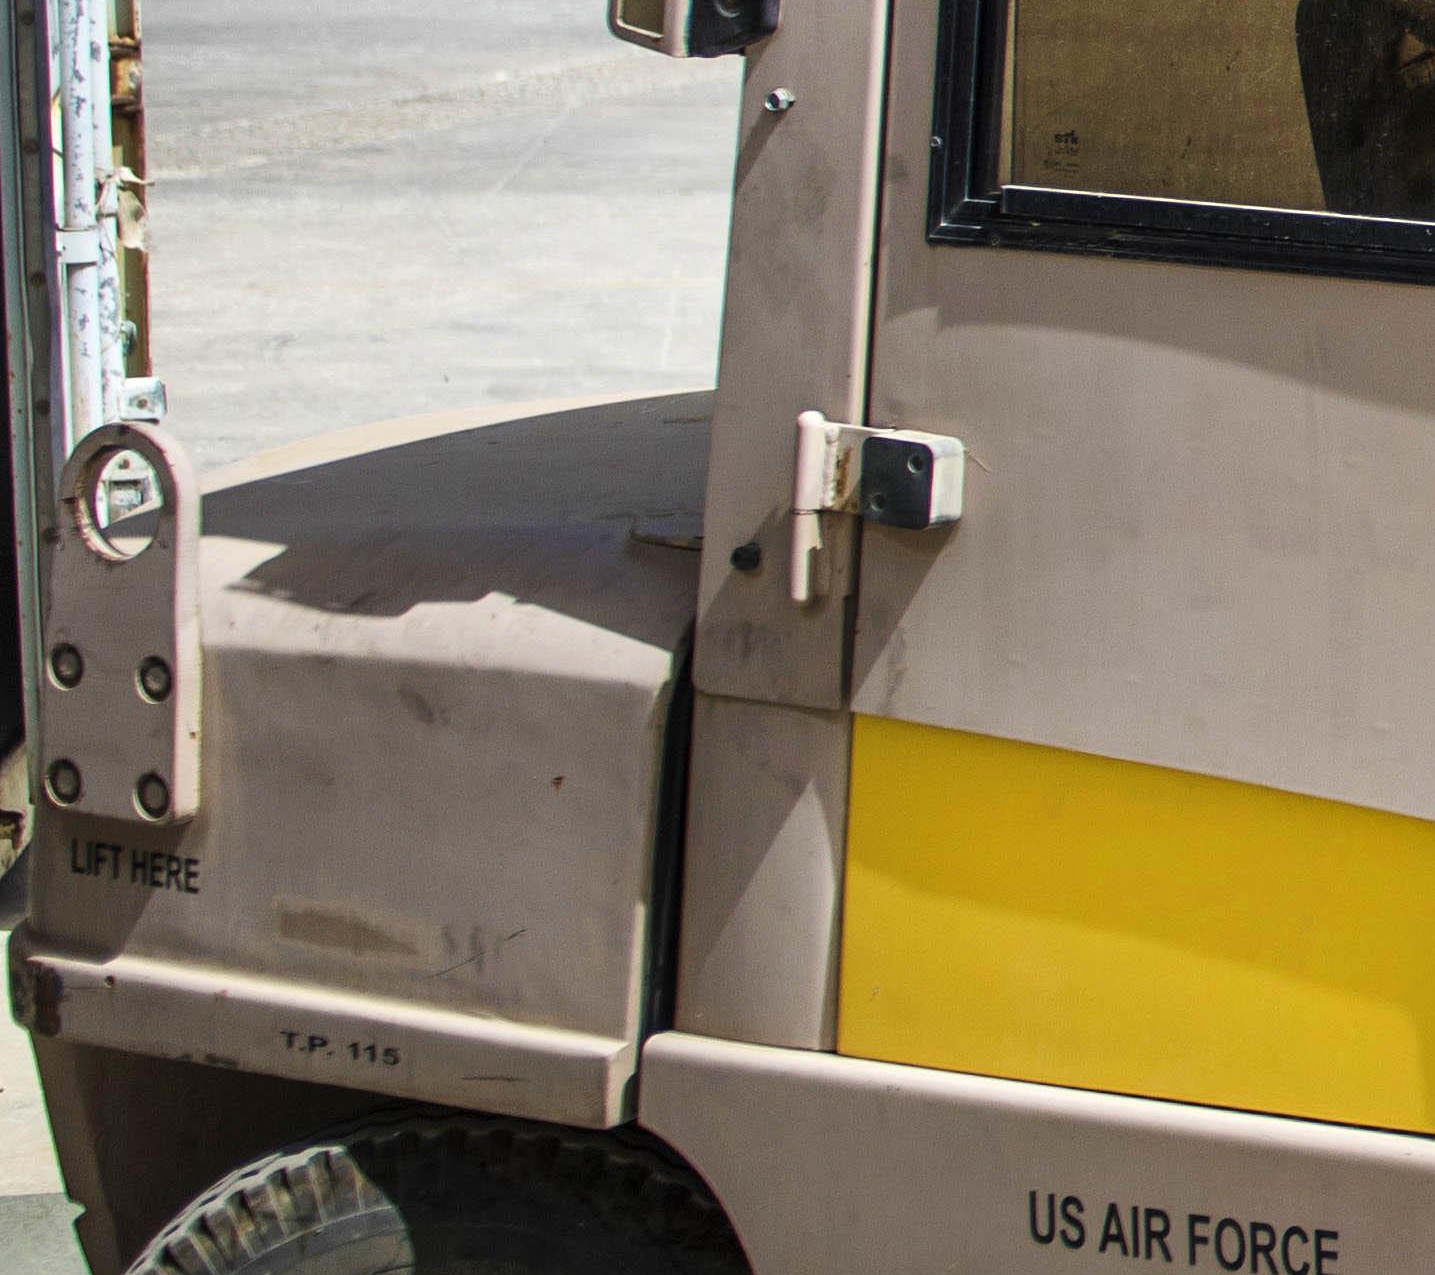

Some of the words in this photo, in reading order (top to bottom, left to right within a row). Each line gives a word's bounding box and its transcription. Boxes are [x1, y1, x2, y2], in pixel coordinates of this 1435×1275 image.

[70, 838, 122, 880] LIFT
[131, 848, 200, 894] HERE
[279, 1029, 334, 1057] T.P.
[347, 1041, 401, 1066] 115
[1029, 1190, 1086, 1251] US
[1098, 1202, 1172, 1263] AIR
